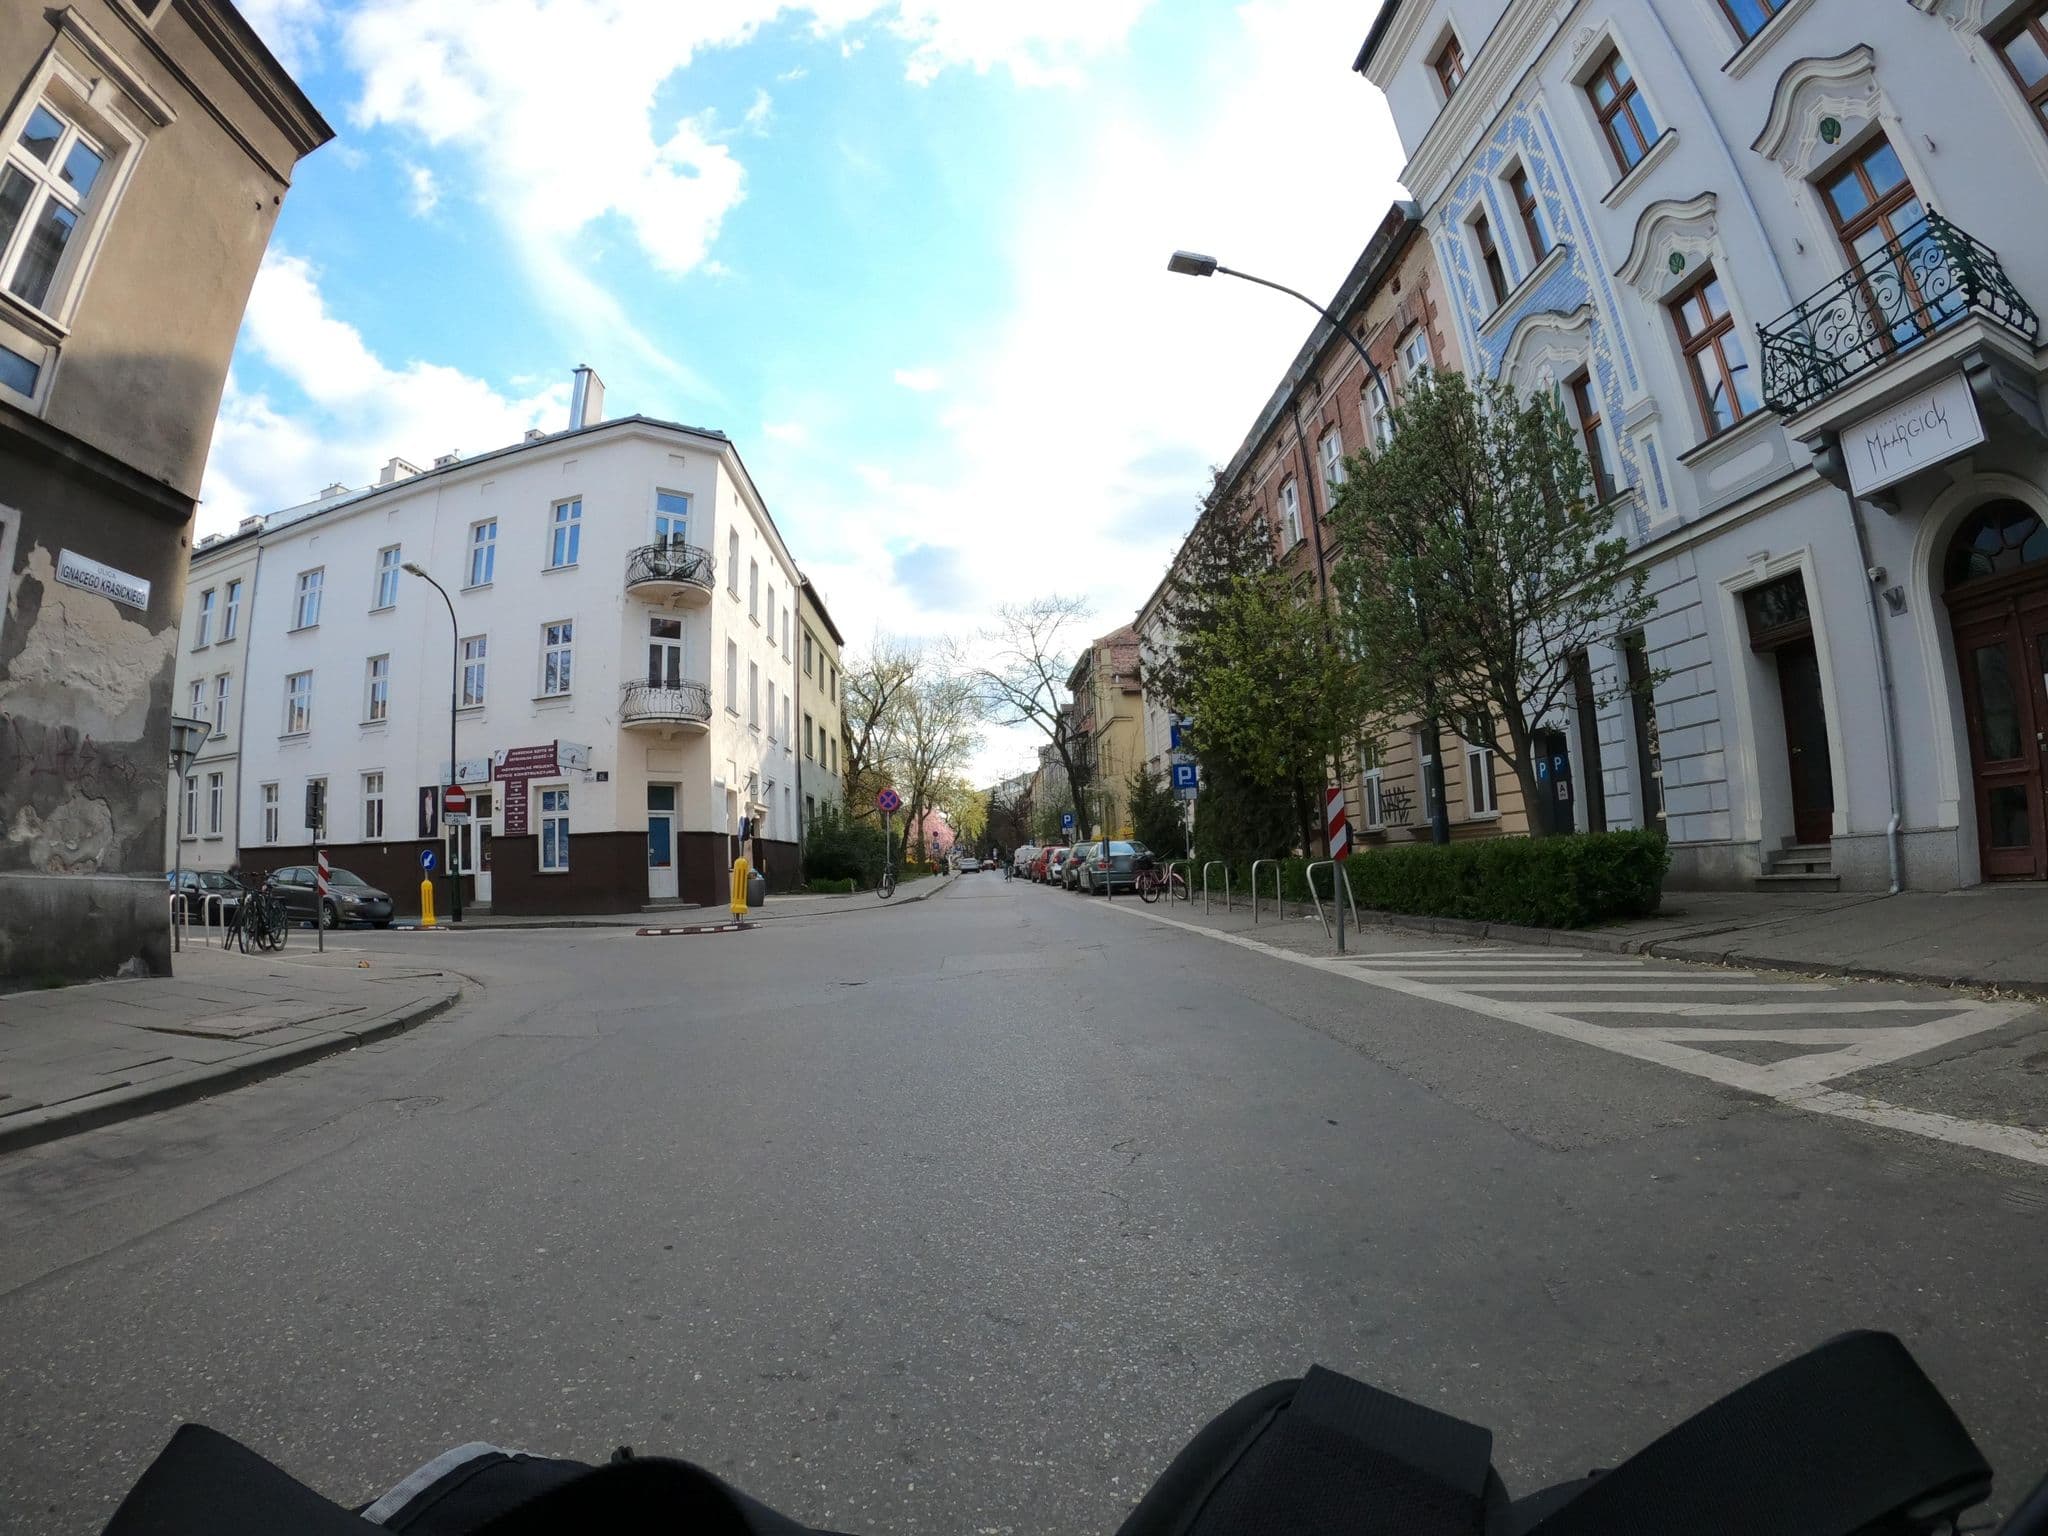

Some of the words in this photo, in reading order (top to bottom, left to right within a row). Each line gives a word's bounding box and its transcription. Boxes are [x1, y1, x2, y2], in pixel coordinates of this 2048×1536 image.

[60, 564, 100, 588] IGNACEGO
[99, 577, 146, 606] KRASICKIEGO
[1539, 762, 1546, 778] P
[1554, 756, 1562, 770] P
[1178, 767, 1191, 785] P
[1064, 815, 1071, 824] P
